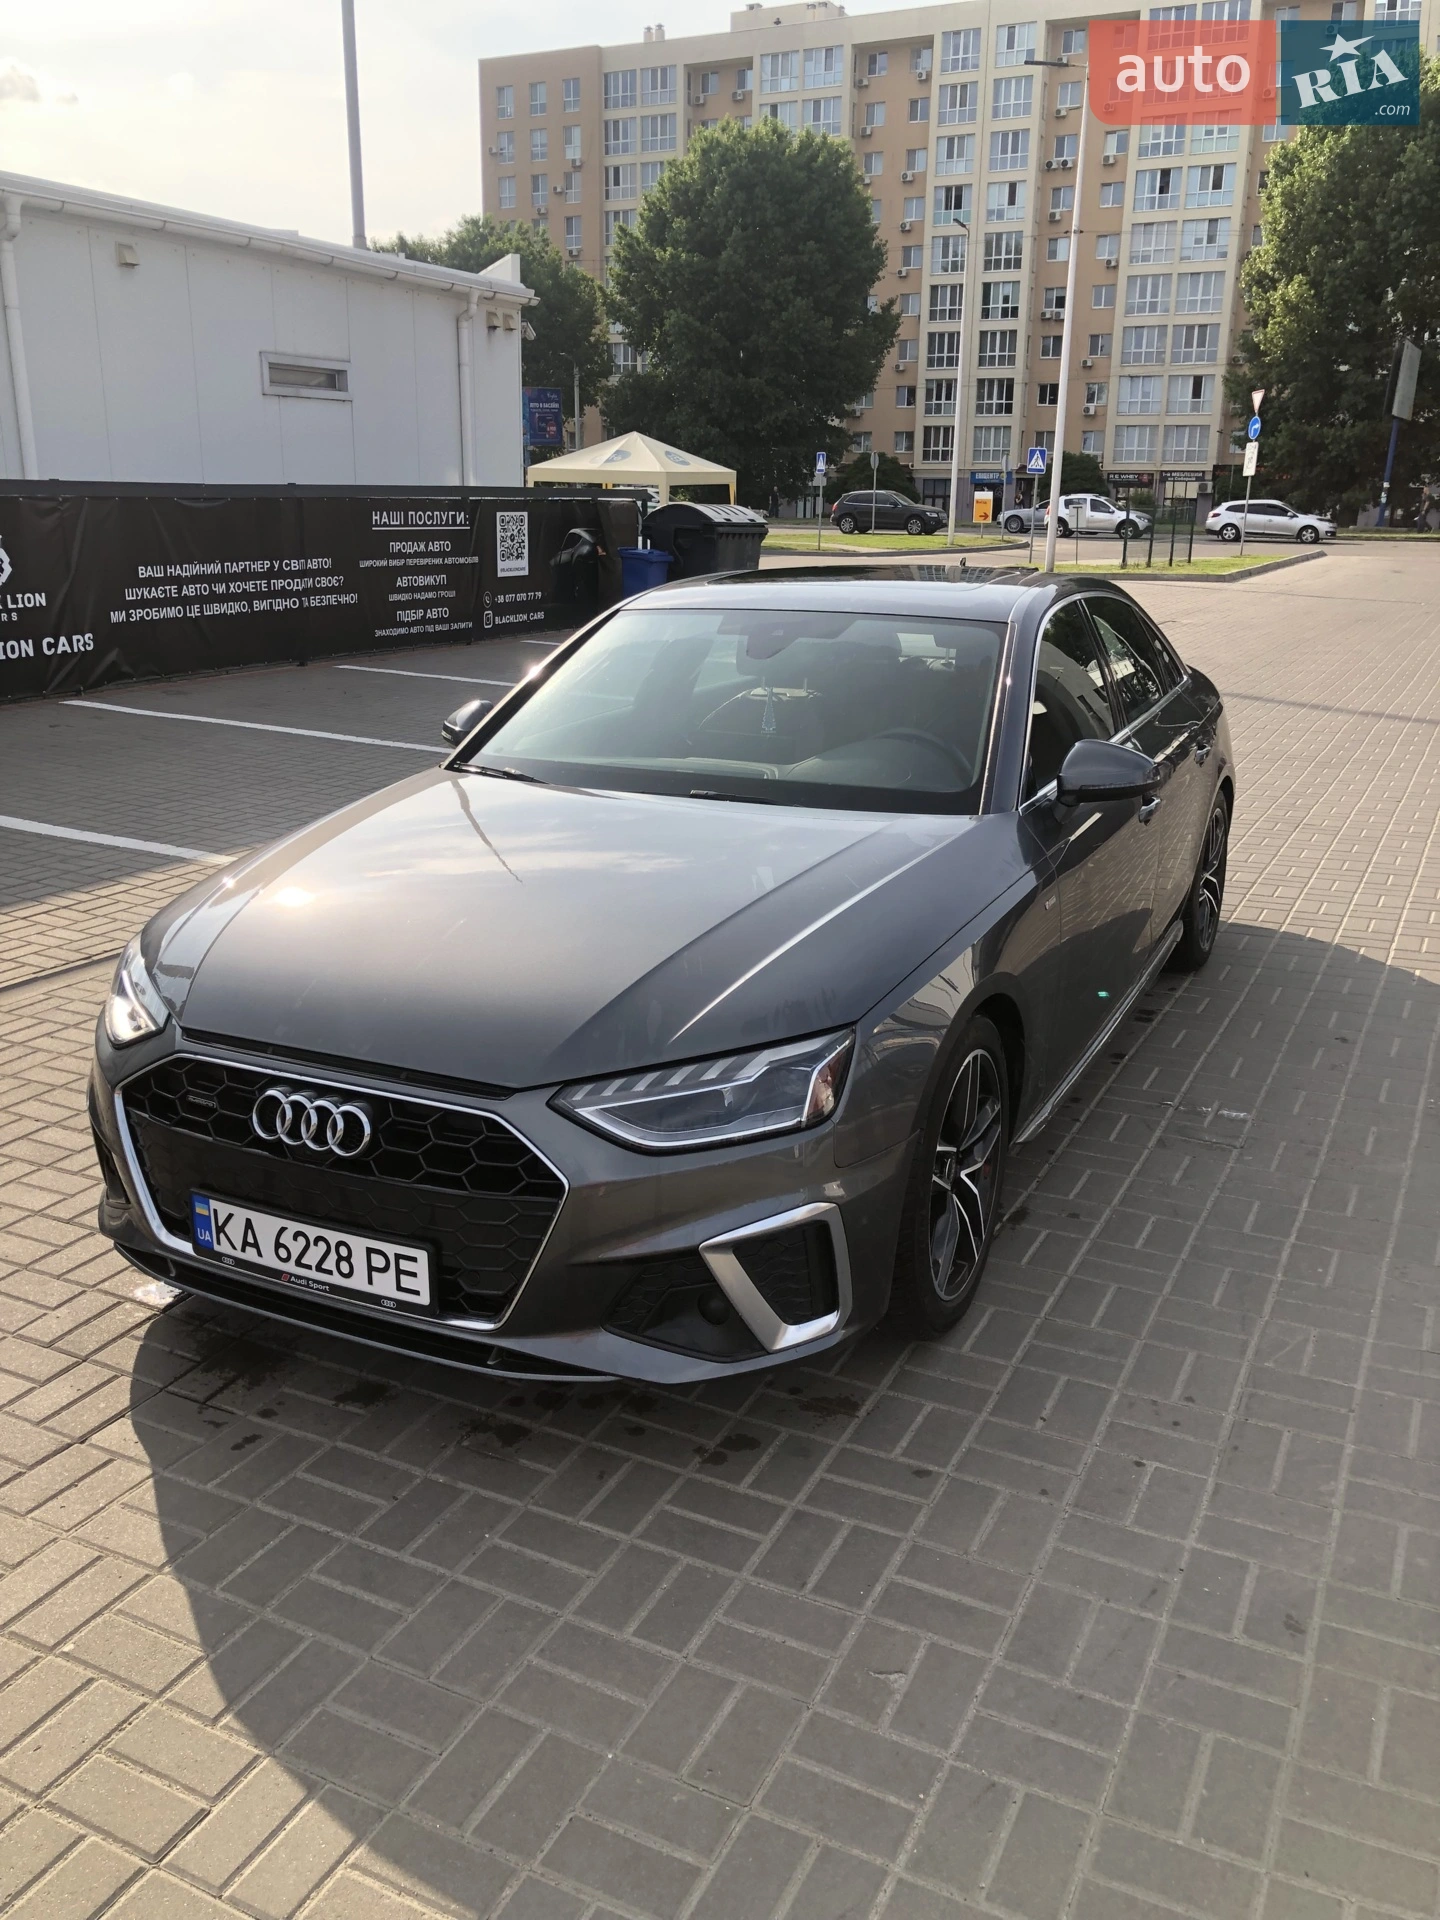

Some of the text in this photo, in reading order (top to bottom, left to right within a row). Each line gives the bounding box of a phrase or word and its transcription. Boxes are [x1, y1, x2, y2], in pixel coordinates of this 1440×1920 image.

[372, 511, 470, 525] НАШІ ПОСЛУГИ:
[389, 541, 452, 554] ПРОДАЖ АВТО
[138, 565, 164, 578] ВАШ
[167, 560, 222, 578] НАДІЙНИЙ
[224, 561, 271, 574] ПАРТНЕР
[273, 560, 280, 571] У
[307, 558, 332, 570] АВТО!
[359, 558, 388, 568] ШИРОКИЙ
[389, 558, 405, 567] ВИБІР
[406, 557, 443, 566] ПЕРЕВІРЕНИХ
[125, 576, 344, 600] ШУКАЄТЕ АВТО ЧИ ХОЧЕТЕ ПРОДАТИ СВОЄ?
[396, 574, 447, 587] АВТОВИКУП
[7, 593, 47, 609] LION
[388, 590, 456, 602] ШВИДКО НАДАМО ГРОШІ
[494, 591, 542, 604] +38 077 070 77 79
[110, 610, 126, 623] МИ
[129, 606, 184, 622] ЗРОБИМО
[186, 604, 201, 618] ЦЕ
[203, 601, 251, 616] ШВИДКО,
[253, 598, 300, 612] ВИГІДНО
[310, 593, 358, 607] БЕЗПЕЧНО!
[397, 607, 449, 622] ПІДБІР АВТО
[375, 627, 409, 638] ЗНАХОДИМО
[410, 625, 424, 634] АВТО
[435, 623, 449, 631] ВАШІ
[450, 621, 473, 630] ЗАПИТИ
[0, 633, 94, 660] ION CARS
[197, 1227, 212, 1243] UA
[213, 1208, 421, 1297] KA 6228 PE
[290, 1275, 330, 1292] Audi Sport
